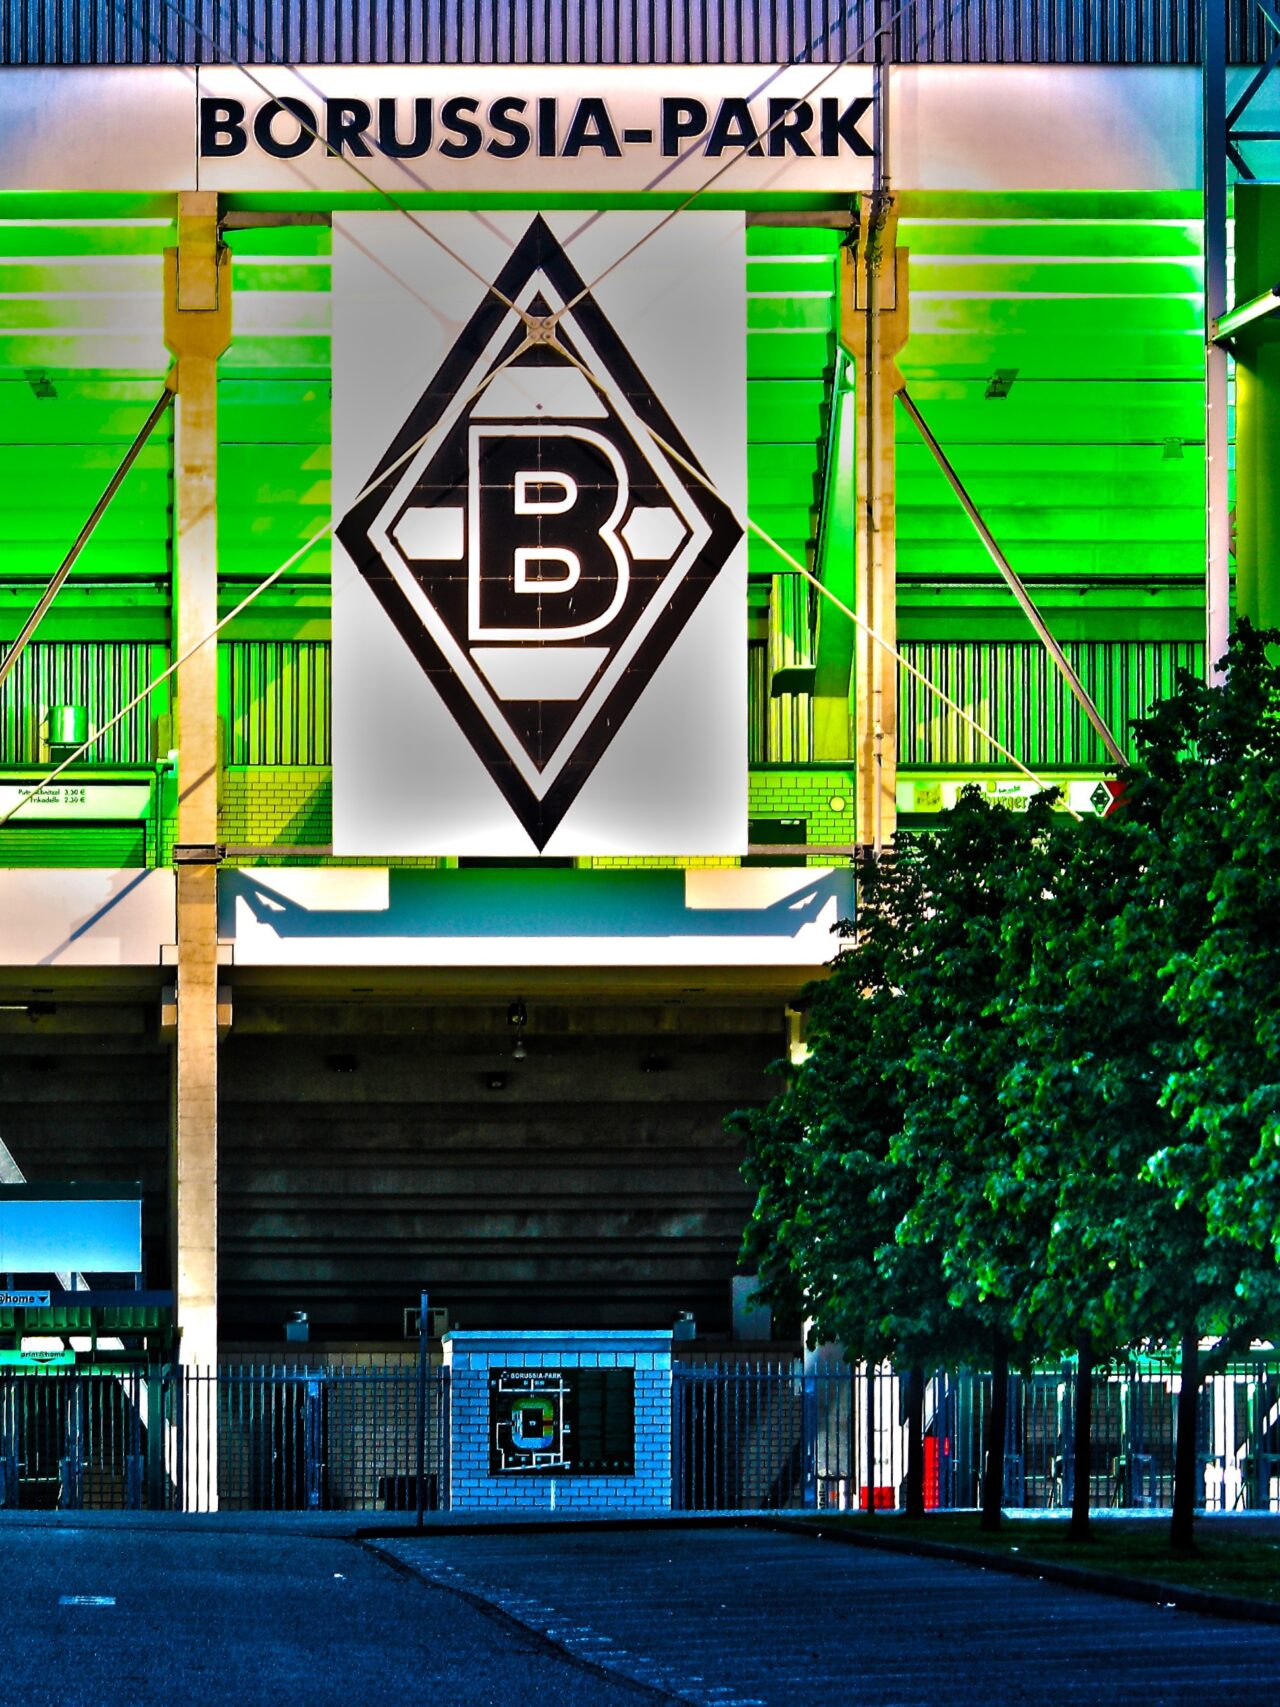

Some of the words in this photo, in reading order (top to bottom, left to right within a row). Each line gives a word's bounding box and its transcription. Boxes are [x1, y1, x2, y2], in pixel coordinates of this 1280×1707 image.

[200, 95, 878, 160] BORUSSIA-PARK
[469, 425, 630, 641] B
[510, 1372, 562, 1380] BORUSSIA-PARK
